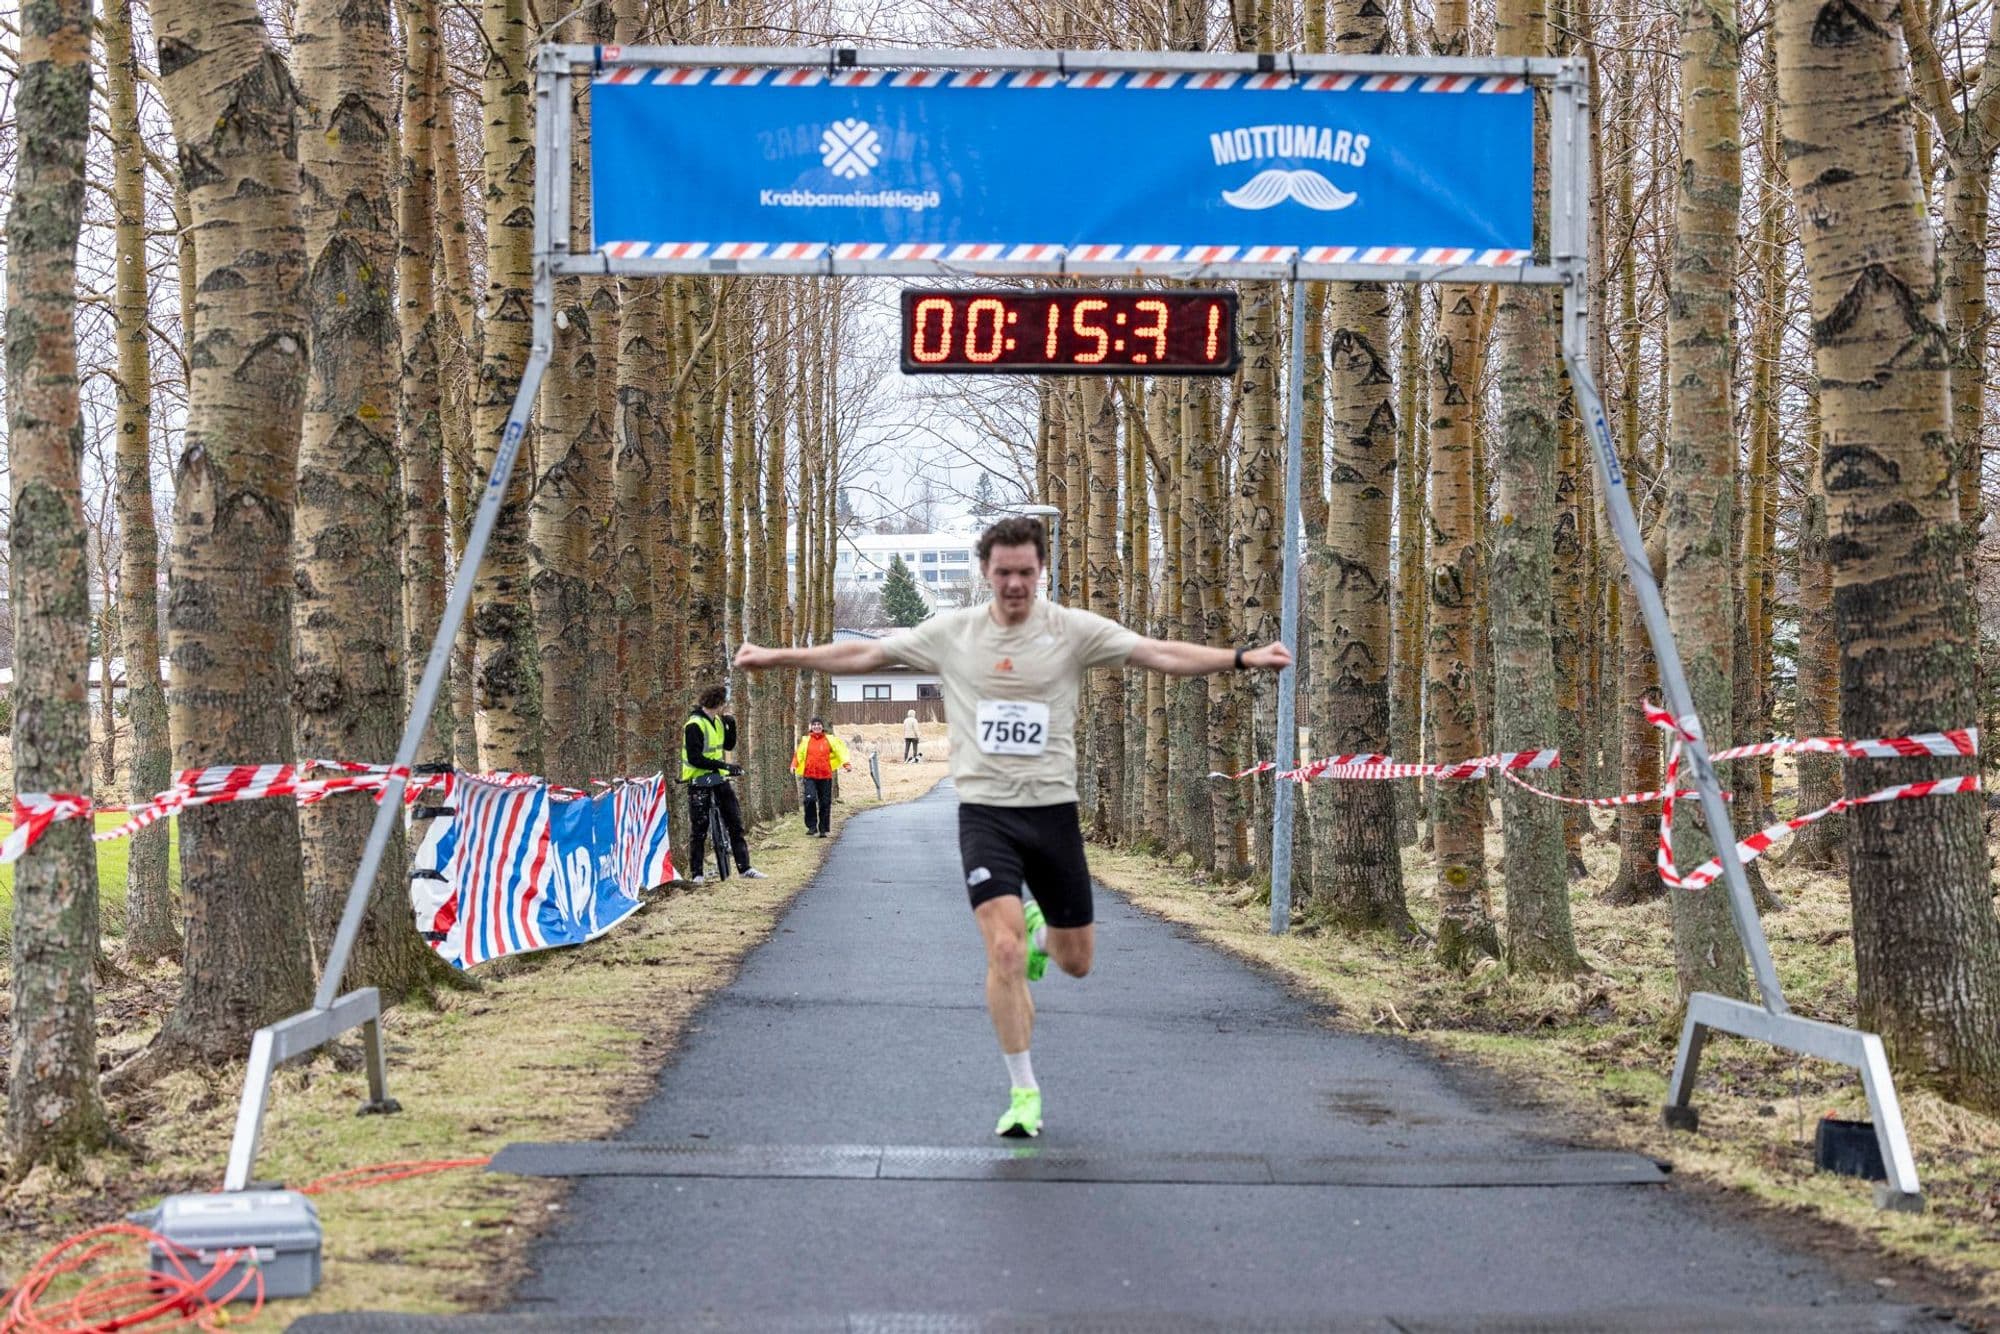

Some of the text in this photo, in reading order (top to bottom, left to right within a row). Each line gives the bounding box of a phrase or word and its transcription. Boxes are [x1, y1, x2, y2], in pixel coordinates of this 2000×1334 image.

[1210, 124, 1370, 167] MOTTUMARS
[760, 189, 940, 212] Krabbameinsfélagið
[913, 298, 1219, 363] 00:15:31
[982, 721, 1042, 744] 7562
